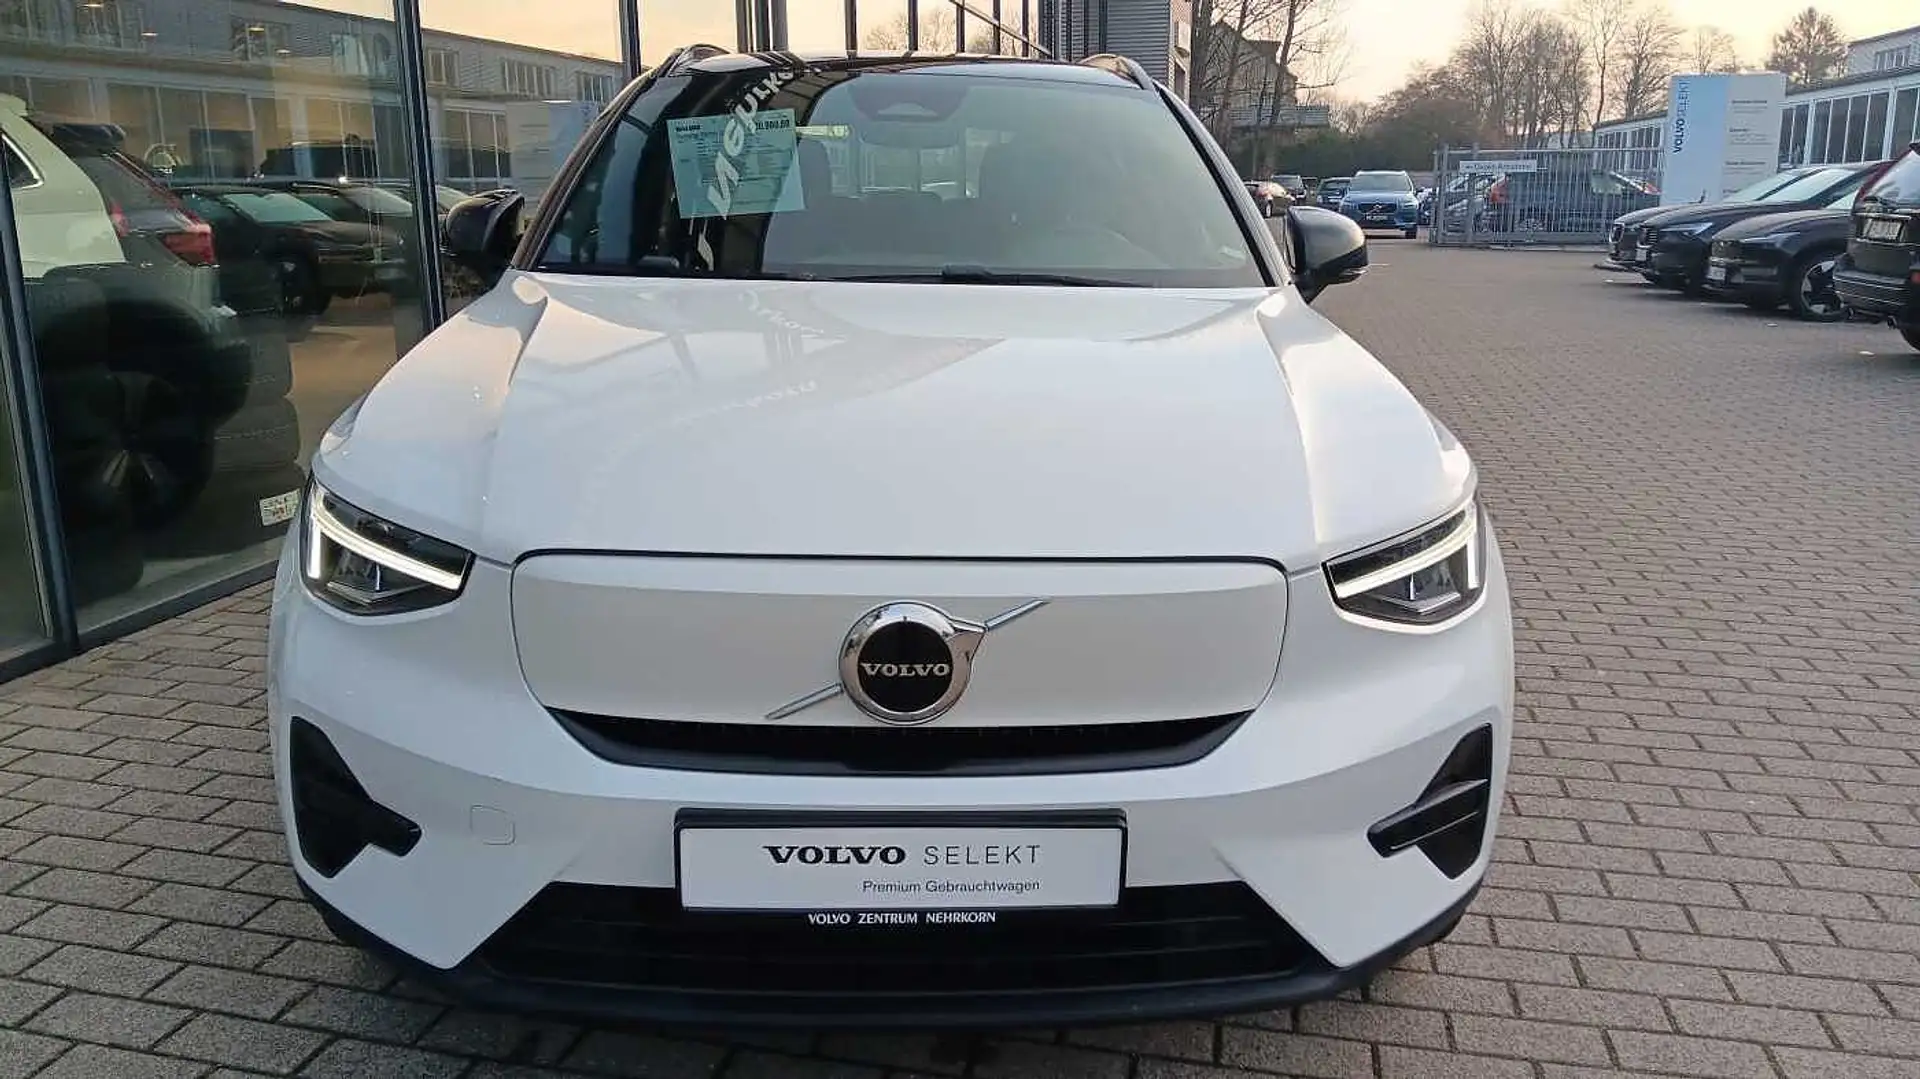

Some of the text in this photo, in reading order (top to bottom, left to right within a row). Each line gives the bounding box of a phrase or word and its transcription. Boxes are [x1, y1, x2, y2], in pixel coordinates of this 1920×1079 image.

[1672, 118, 1685, 153] VOLVO
[861, 662, 951, 677] VOLVO
[763, 845, 1040, 865] VOLVO SELEKT
[862, 879, 1040, 896] Premium Gebrauchtwagen
[808, 911, 996, 924] VOLVO ZENTRUM NEHRKORN
